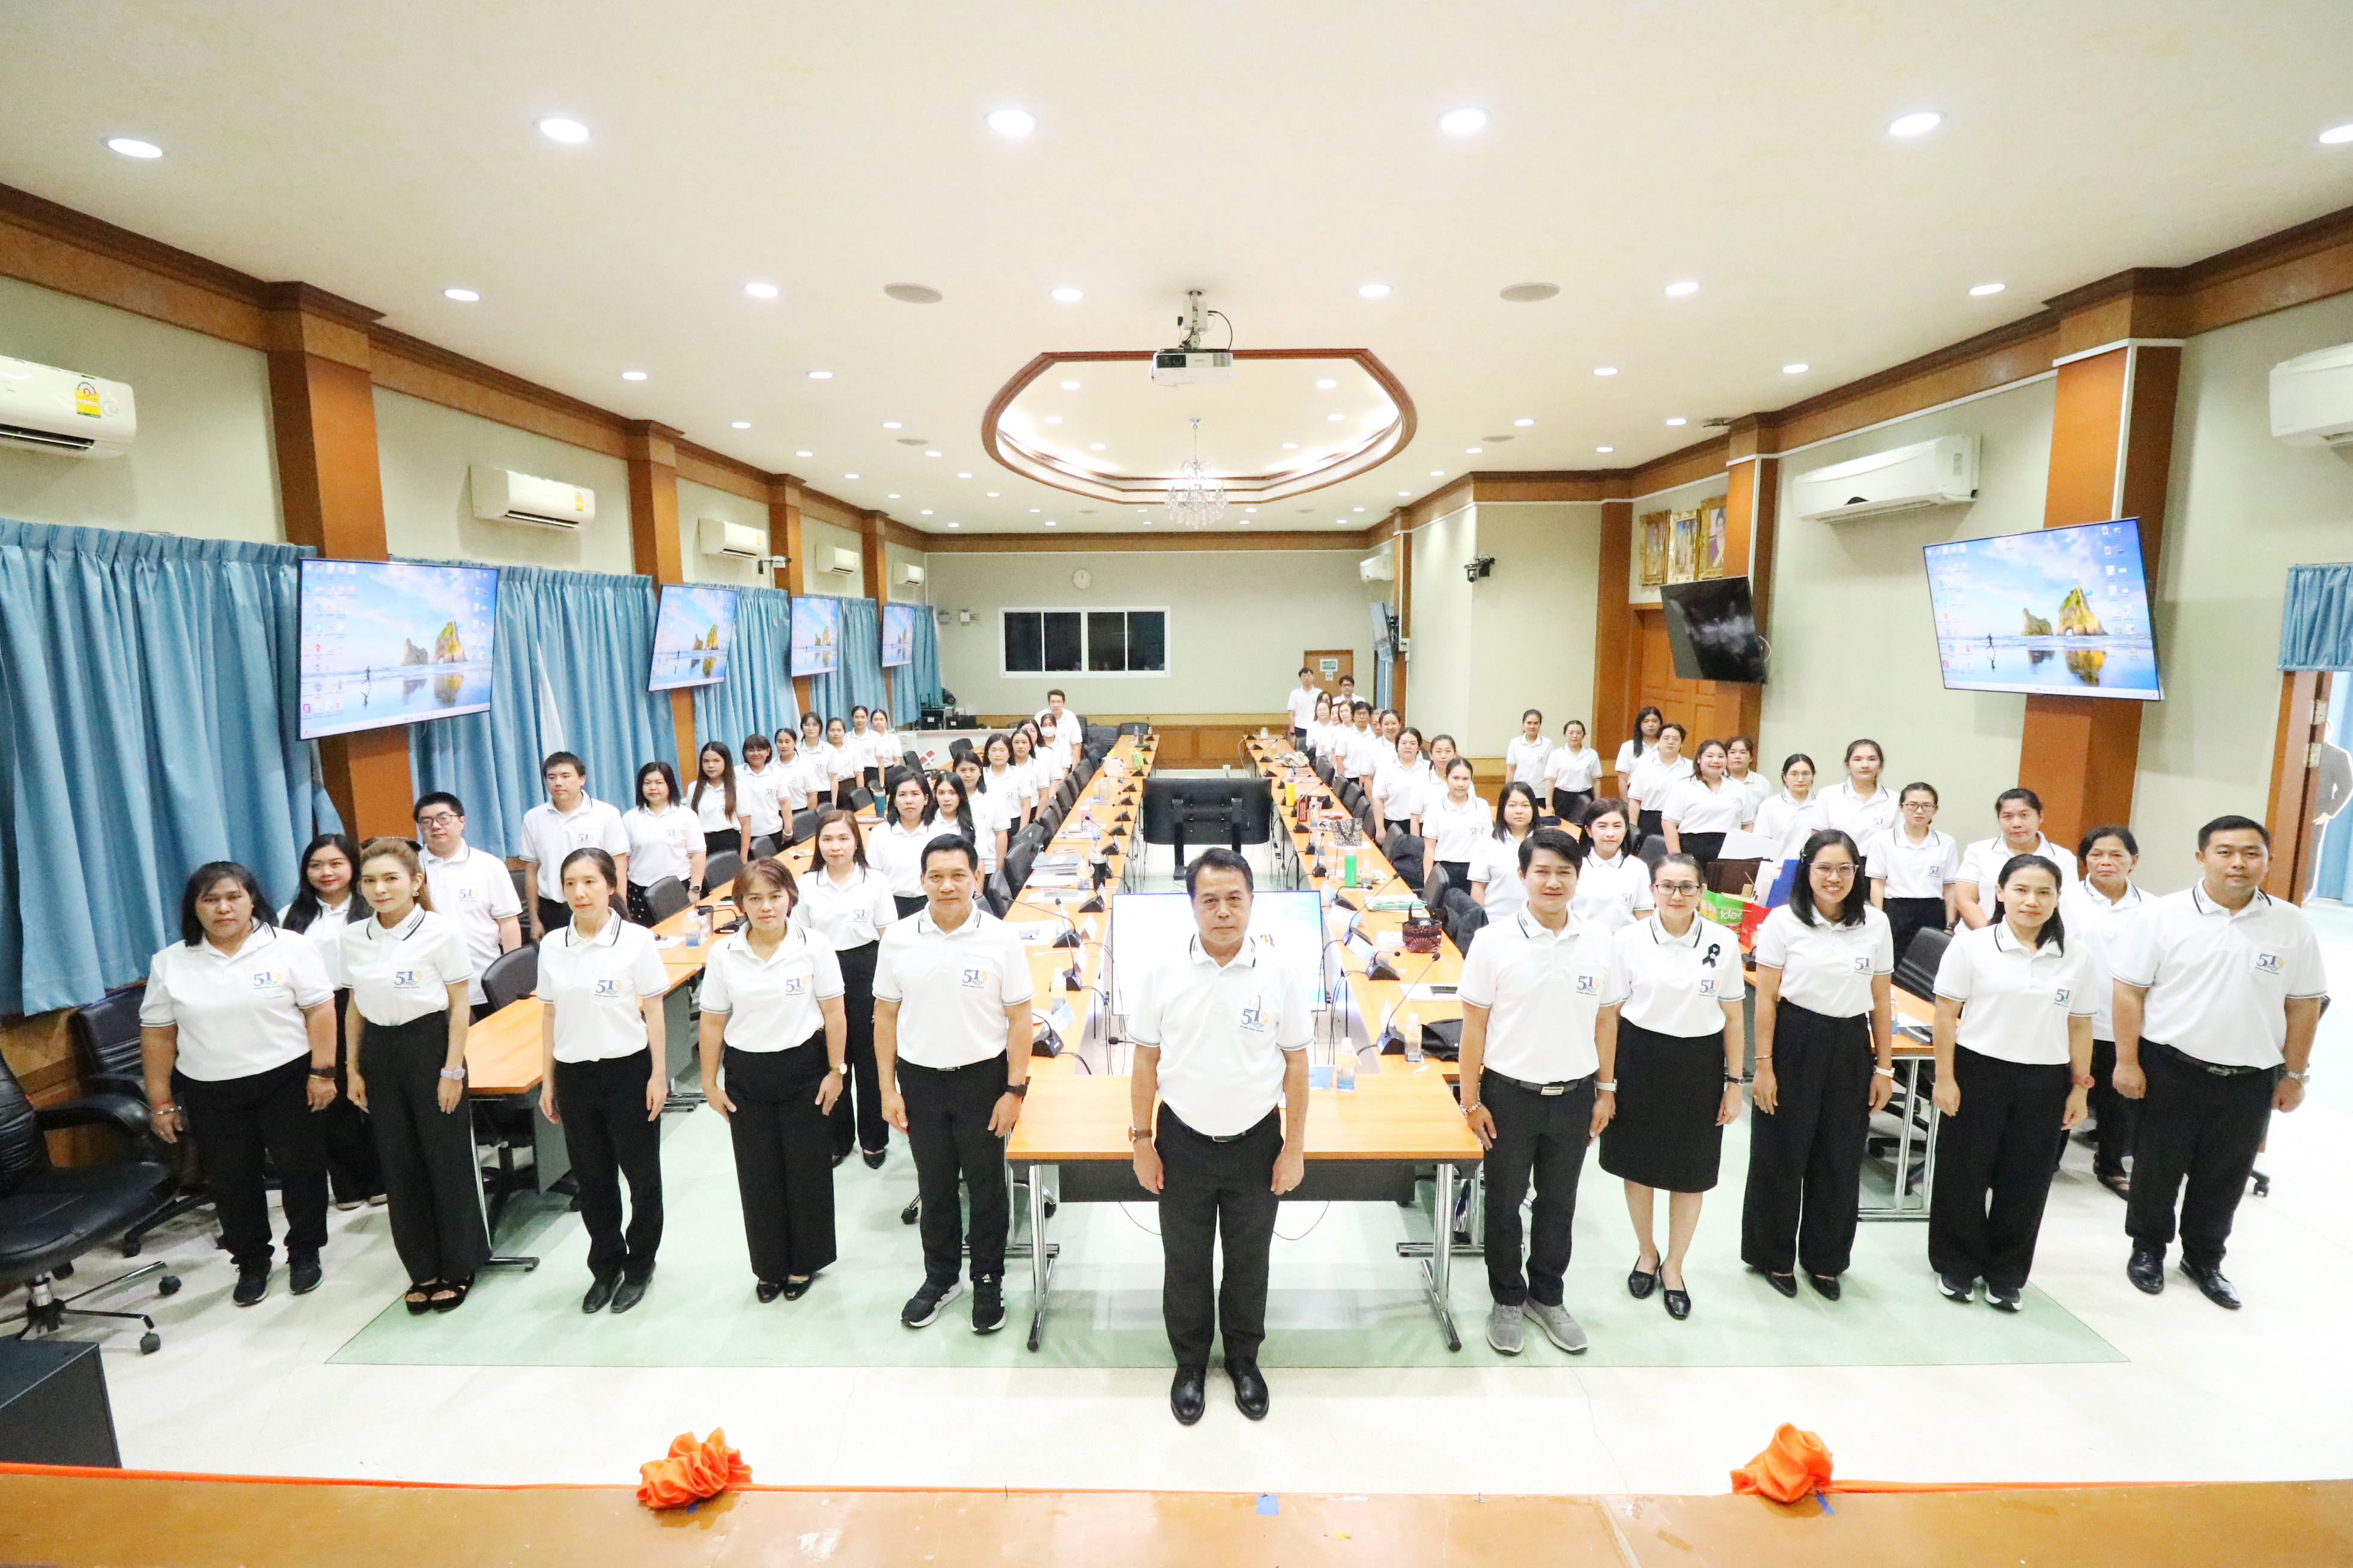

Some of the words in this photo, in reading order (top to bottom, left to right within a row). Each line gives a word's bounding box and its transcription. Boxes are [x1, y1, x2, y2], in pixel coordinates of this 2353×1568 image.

[1854, 957, 1869, 970] 51
[2257, 953, 2277, 967] 51
[253, 971, 271, 986] 51
[394, 970, 413, 985] 51
[962, 969, 979, 983] 51
[1577, 975, 1592, 990] 51
[595, 979, 613, 993] 51
[786, 978, 800, 993] 51
[1699, 979, 1714, 993] 51
[2055, 988, 2069, 1002] 51
[1241, 1009, 1259, 1025] 51
